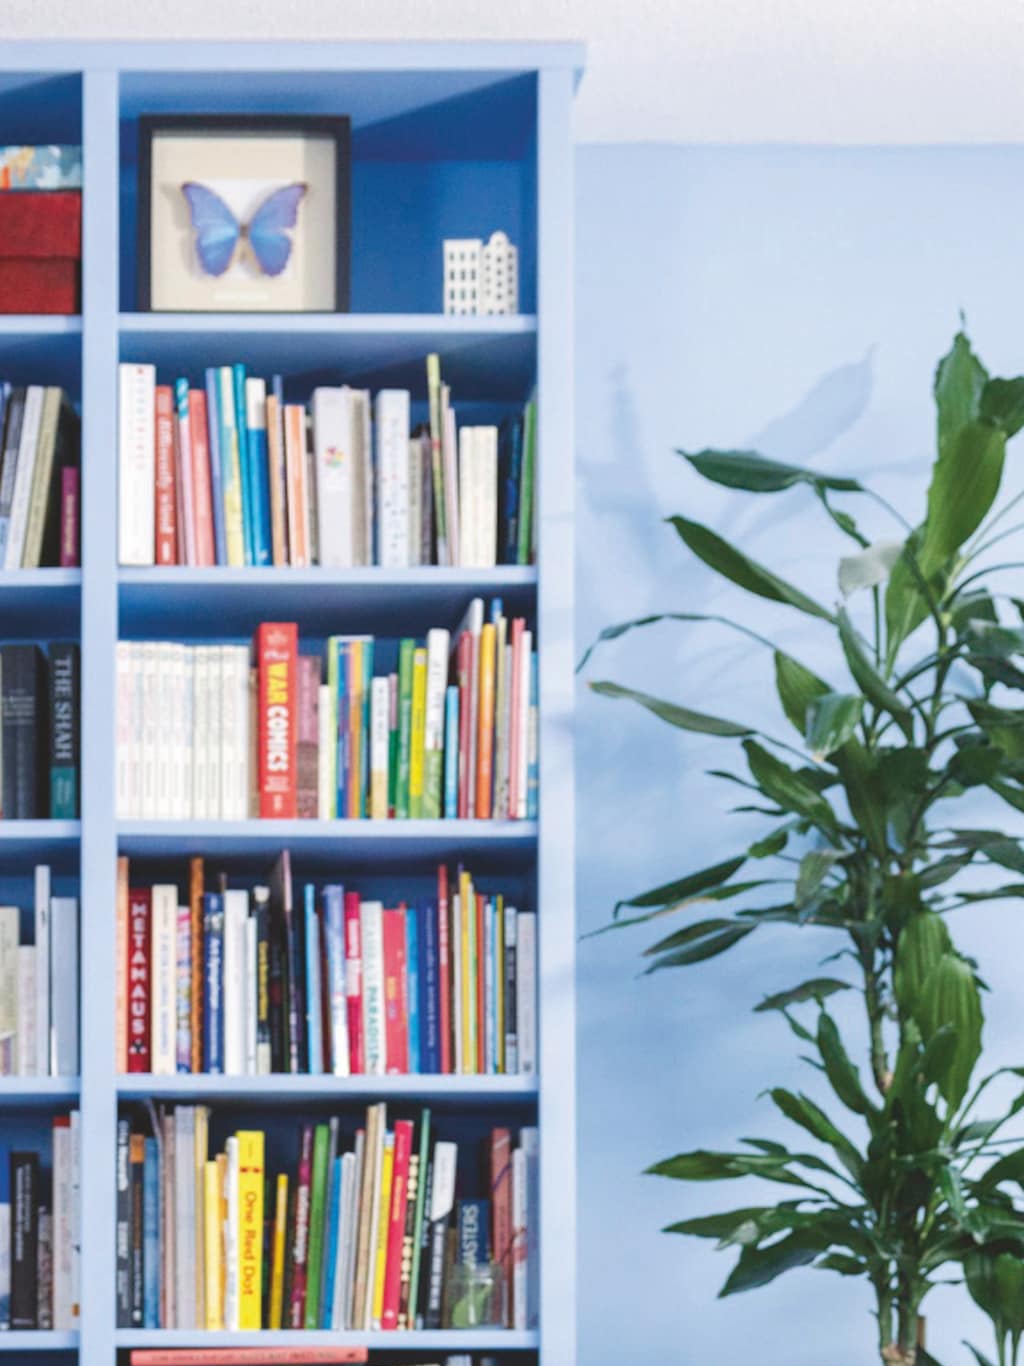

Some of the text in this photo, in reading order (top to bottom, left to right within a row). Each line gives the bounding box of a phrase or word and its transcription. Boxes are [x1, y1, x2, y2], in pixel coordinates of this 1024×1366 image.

[55, 656, 72, 698] THE
[266, 661, 288, 772] WAR COMICS
[54, 701, 72, 760] SHAH
[242, 1190, 257, 1296] One Red Dot
